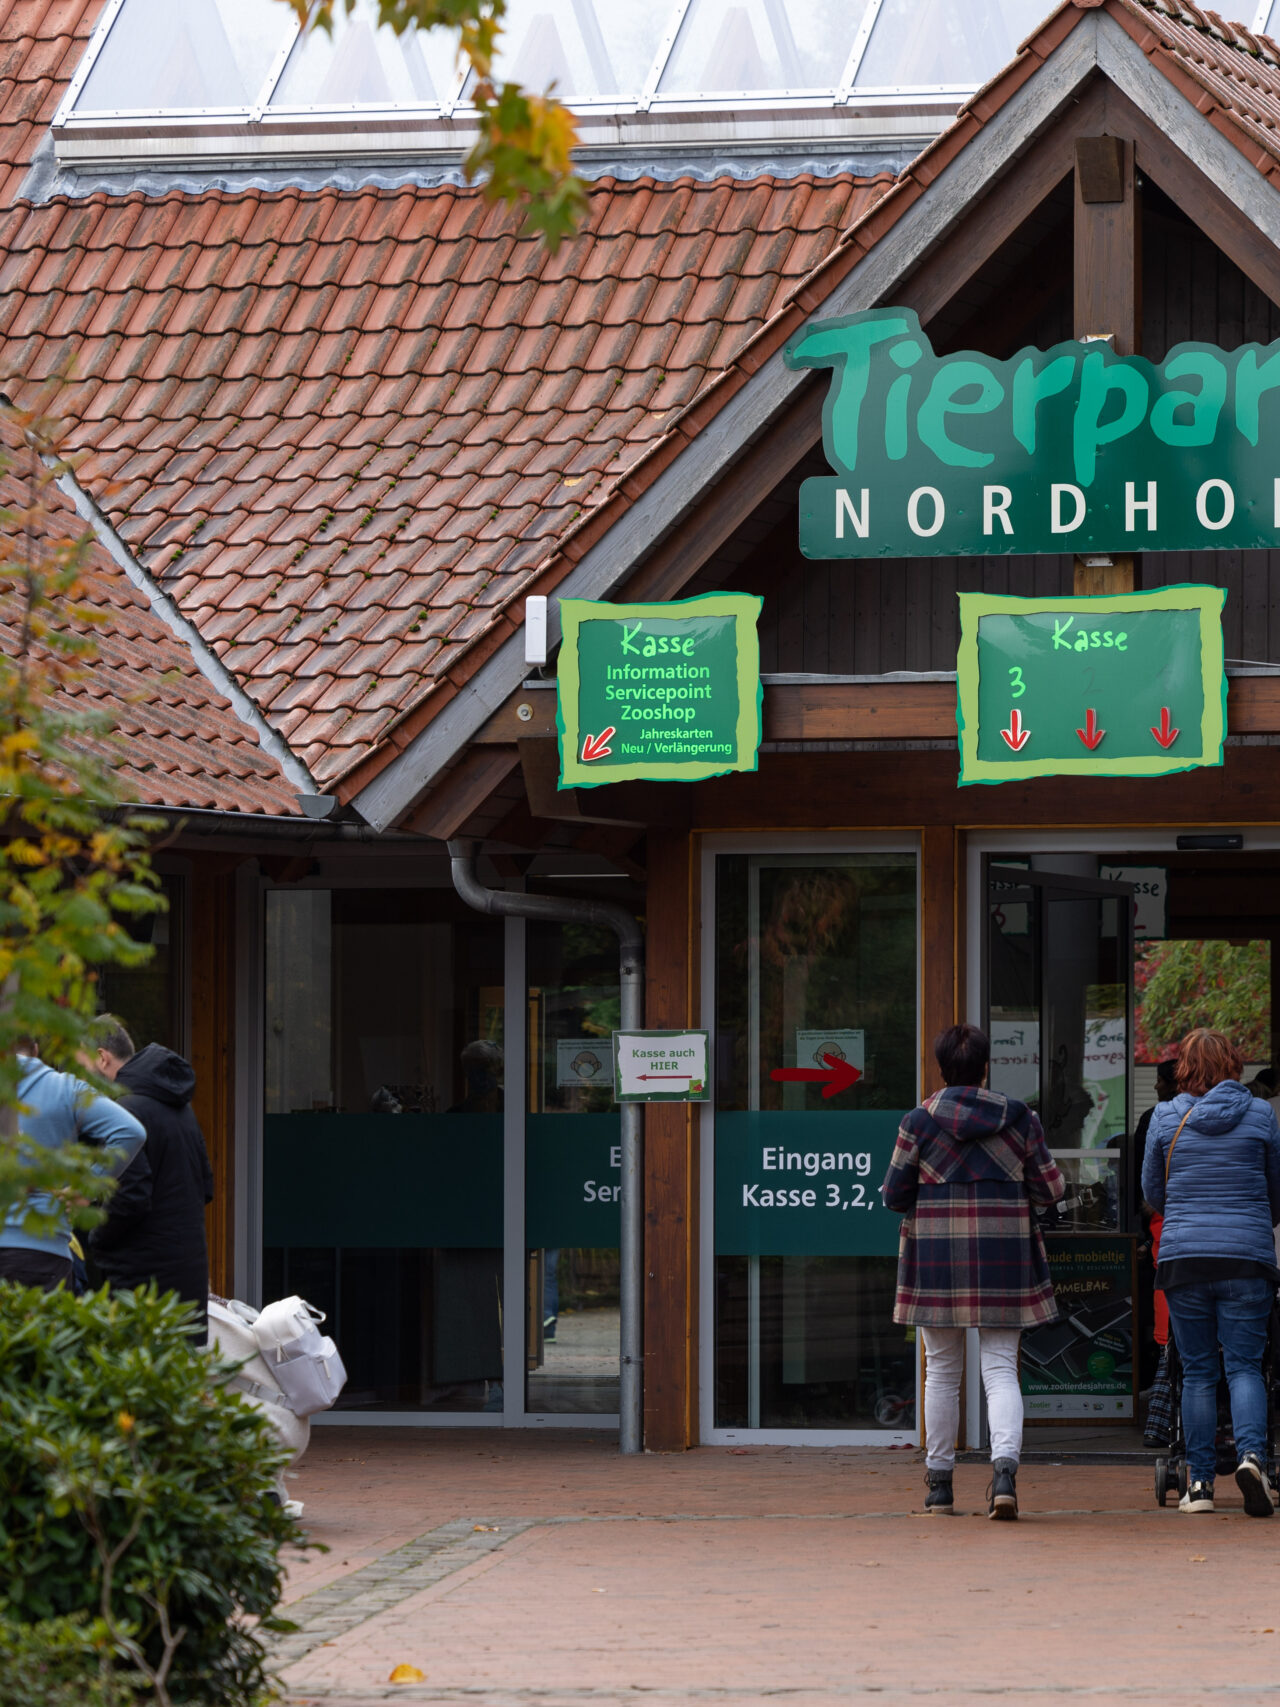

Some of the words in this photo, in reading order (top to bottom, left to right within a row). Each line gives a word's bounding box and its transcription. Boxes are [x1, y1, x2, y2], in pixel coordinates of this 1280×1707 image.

[620, 622, 695, 657] Kasse
[1051, 616, 1128, 652] Kasse
[607, 663, 710, 680] Information
[1008, 666, 1026, 698] 3
[605, 683, 712, 703] Servicepoint
[620, 704, 696, 723] Zooshop
[639, 728, 713, 740] Jahreskarten
[621, 743, 644, 754] Neu
[654, 742, 732, 755] Verlängerung
[632, 1049, 666, 1058] Kasse
[669, 1048, 696, 1058] auch
[650, 1061, 679, 1070] HIER
[762, 1147, 871, 1176] Eingang
[742, 1185, 817, 1207] Kasse
[1074, 1250, 1125, 1264] mobieltje
[1028, 1381, 1127, 1391] www.zootierdesjahres.de
